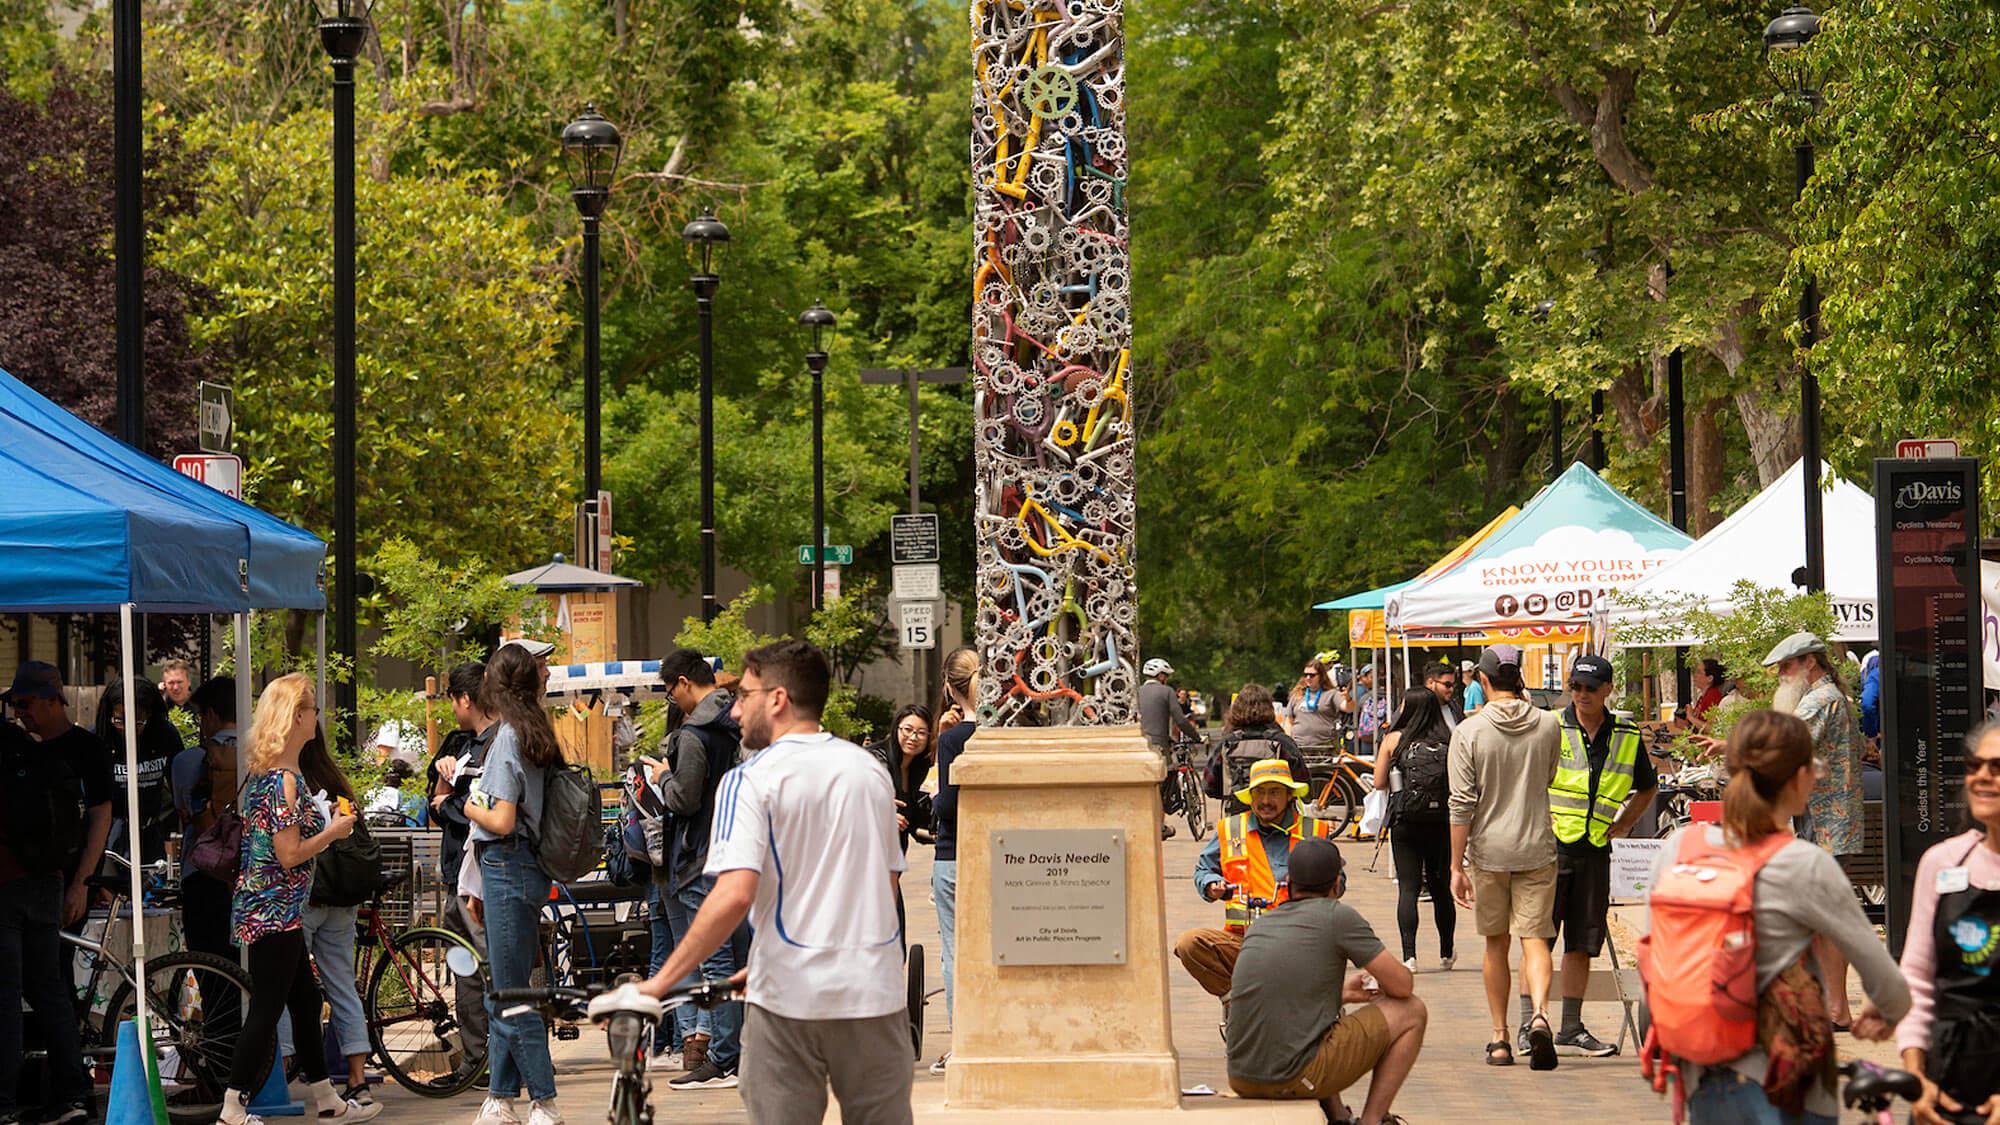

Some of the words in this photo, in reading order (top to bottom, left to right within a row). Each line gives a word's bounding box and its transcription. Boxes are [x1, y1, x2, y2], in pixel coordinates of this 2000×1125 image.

[182, 462, 201, 480] NO
[1912, 481, 1961, 500] Davis
[1896, 521, 1925, 530] Cyclists
[1926, 520, 1962, 530] Yesterday
[802, 549, 810, 561] A
[1904, 556, 1932, 565] Cyclists
[1934, 556, 1955, 564] Today
[1482, 561, 1560, 578] KNOW
[1566, 559, 1633, 573] YOUR
[1483, 577, 1537, 587] GROW
[1544, 573, 1592, 584] YOUR
[903, 607, 931, 615] SPEED
[907, 626, 928, 643] 15
[1915, 739, 1927, 765] Year
[1916, 767, 1928, 787] this
[1917, 789, 1931, 832] Cyclists
[1004, 854, 1025, 865] The
[1028, 853, 1062, 864] Davis
[1065, 853, 1111, 864] Needle
[1046, 867, 1069, 877] 2019
